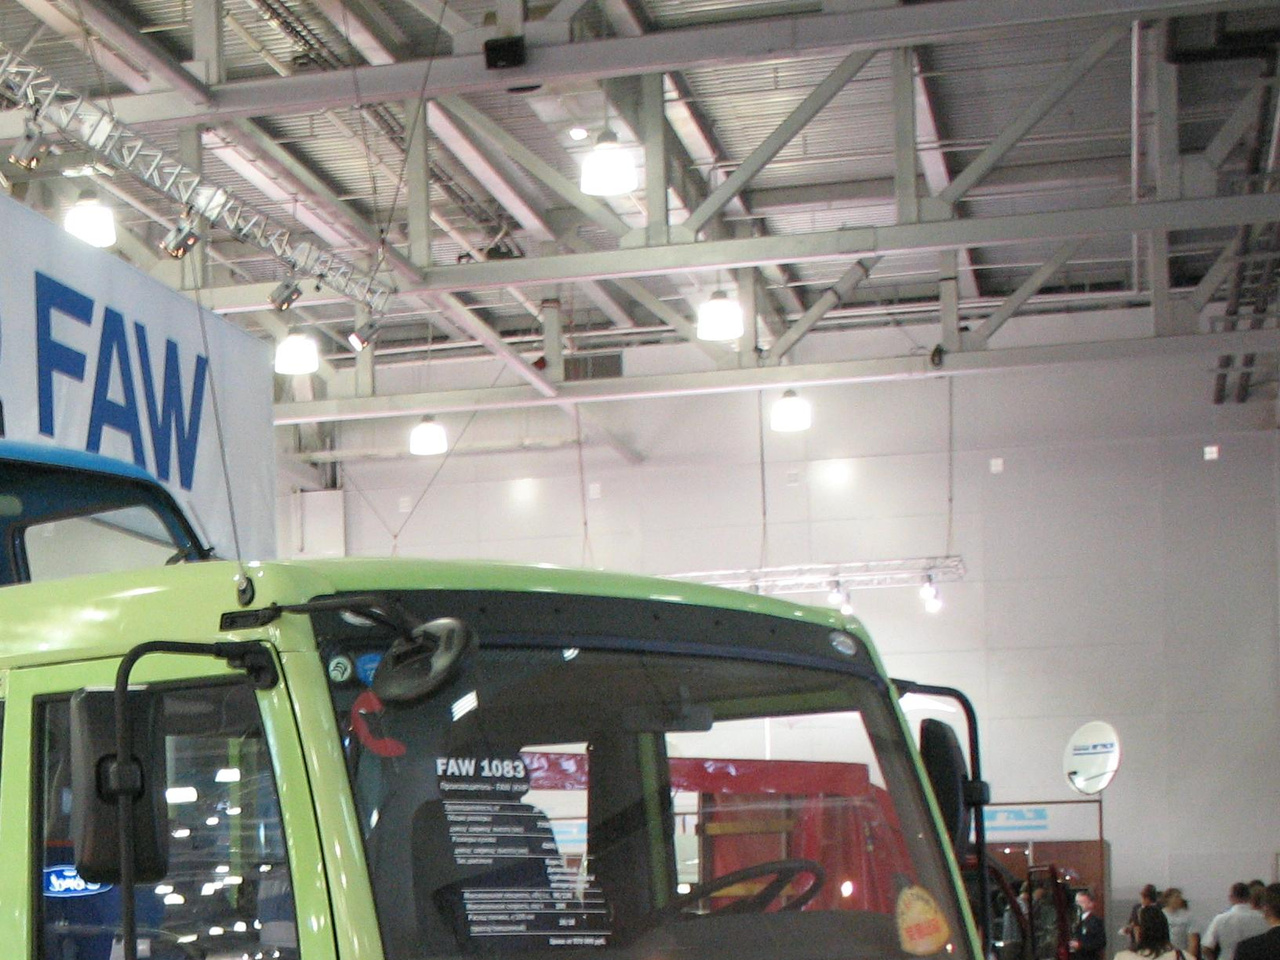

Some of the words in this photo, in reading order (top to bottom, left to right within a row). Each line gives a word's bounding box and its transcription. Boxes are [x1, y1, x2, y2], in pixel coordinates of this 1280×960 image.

[35, 271, 208, 491] FAW
[436, 757, 476, 777] FAW
[480, 757, 526, 779] 1083
